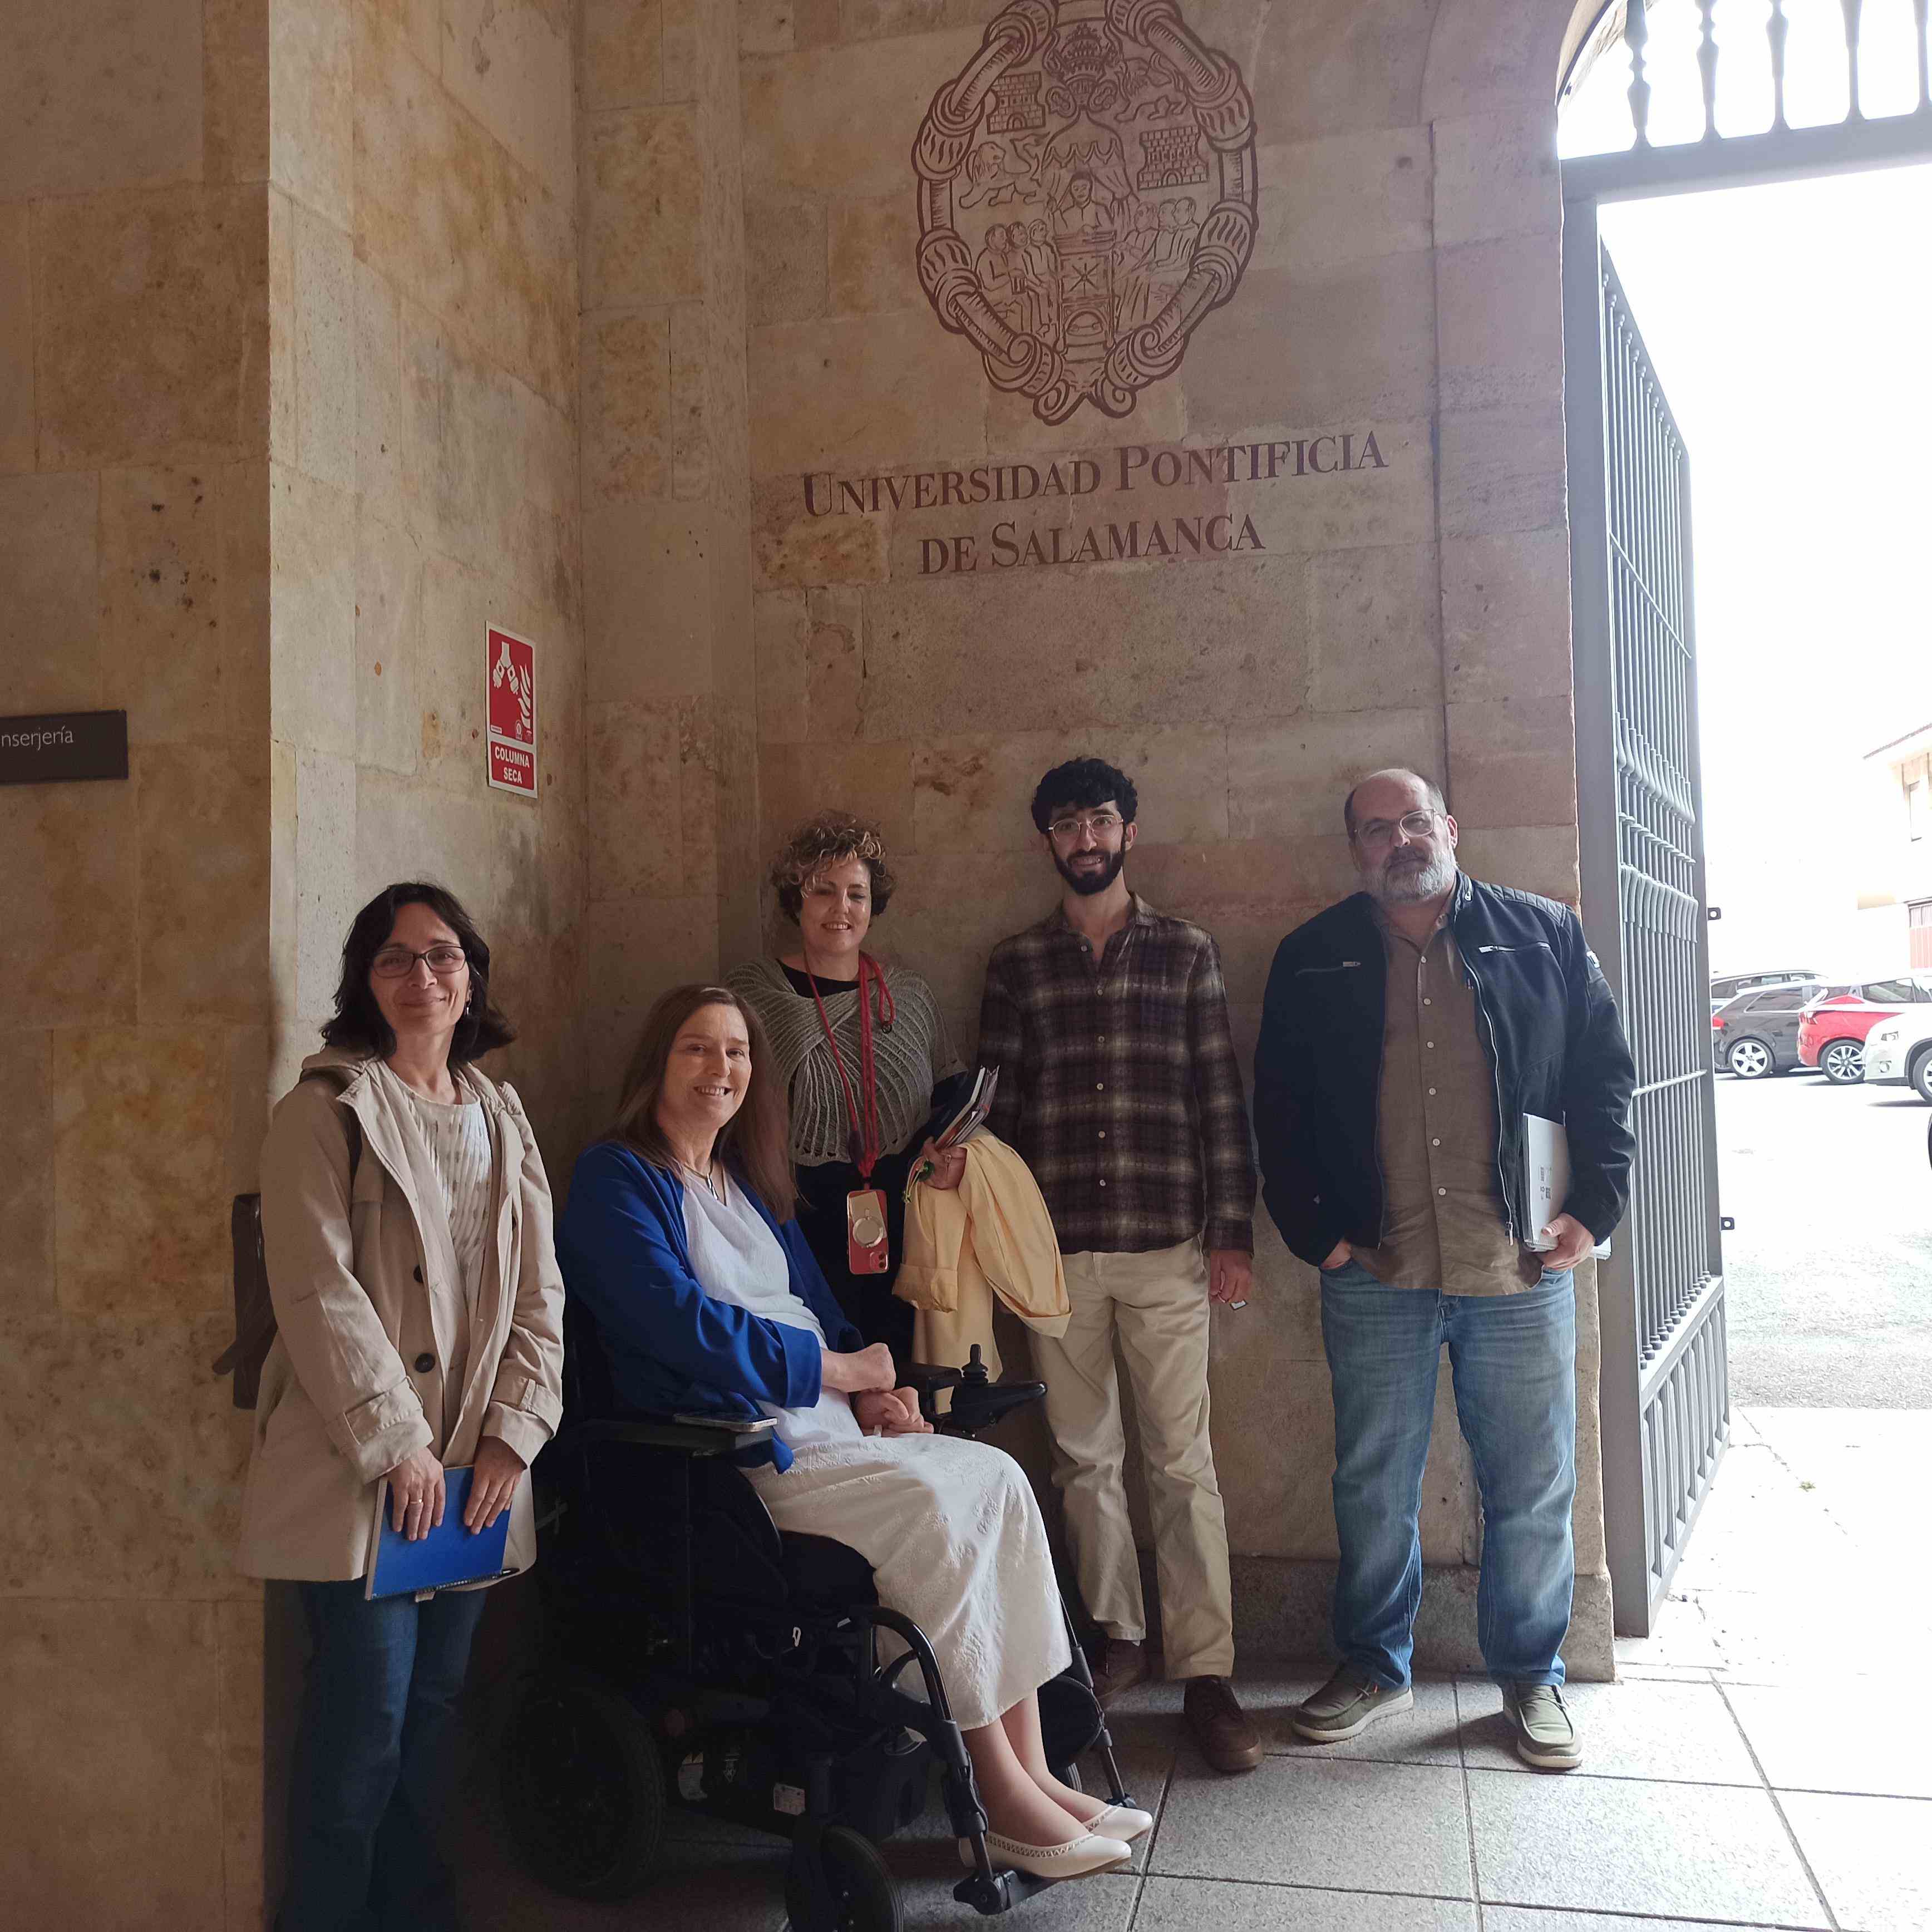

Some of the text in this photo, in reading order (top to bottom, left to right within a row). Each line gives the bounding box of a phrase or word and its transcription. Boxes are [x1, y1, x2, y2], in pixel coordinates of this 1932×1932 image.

[801, 431, 1390, 518] UNIVERSIDAD PONTIFICIA
[918, 514, 1266, 575] DE SALAMANCA
[2, 725, 73, 751] nserjería
[495, 746, 530, 768] COLUMNA
[504, 767, 523, 784] SECA
